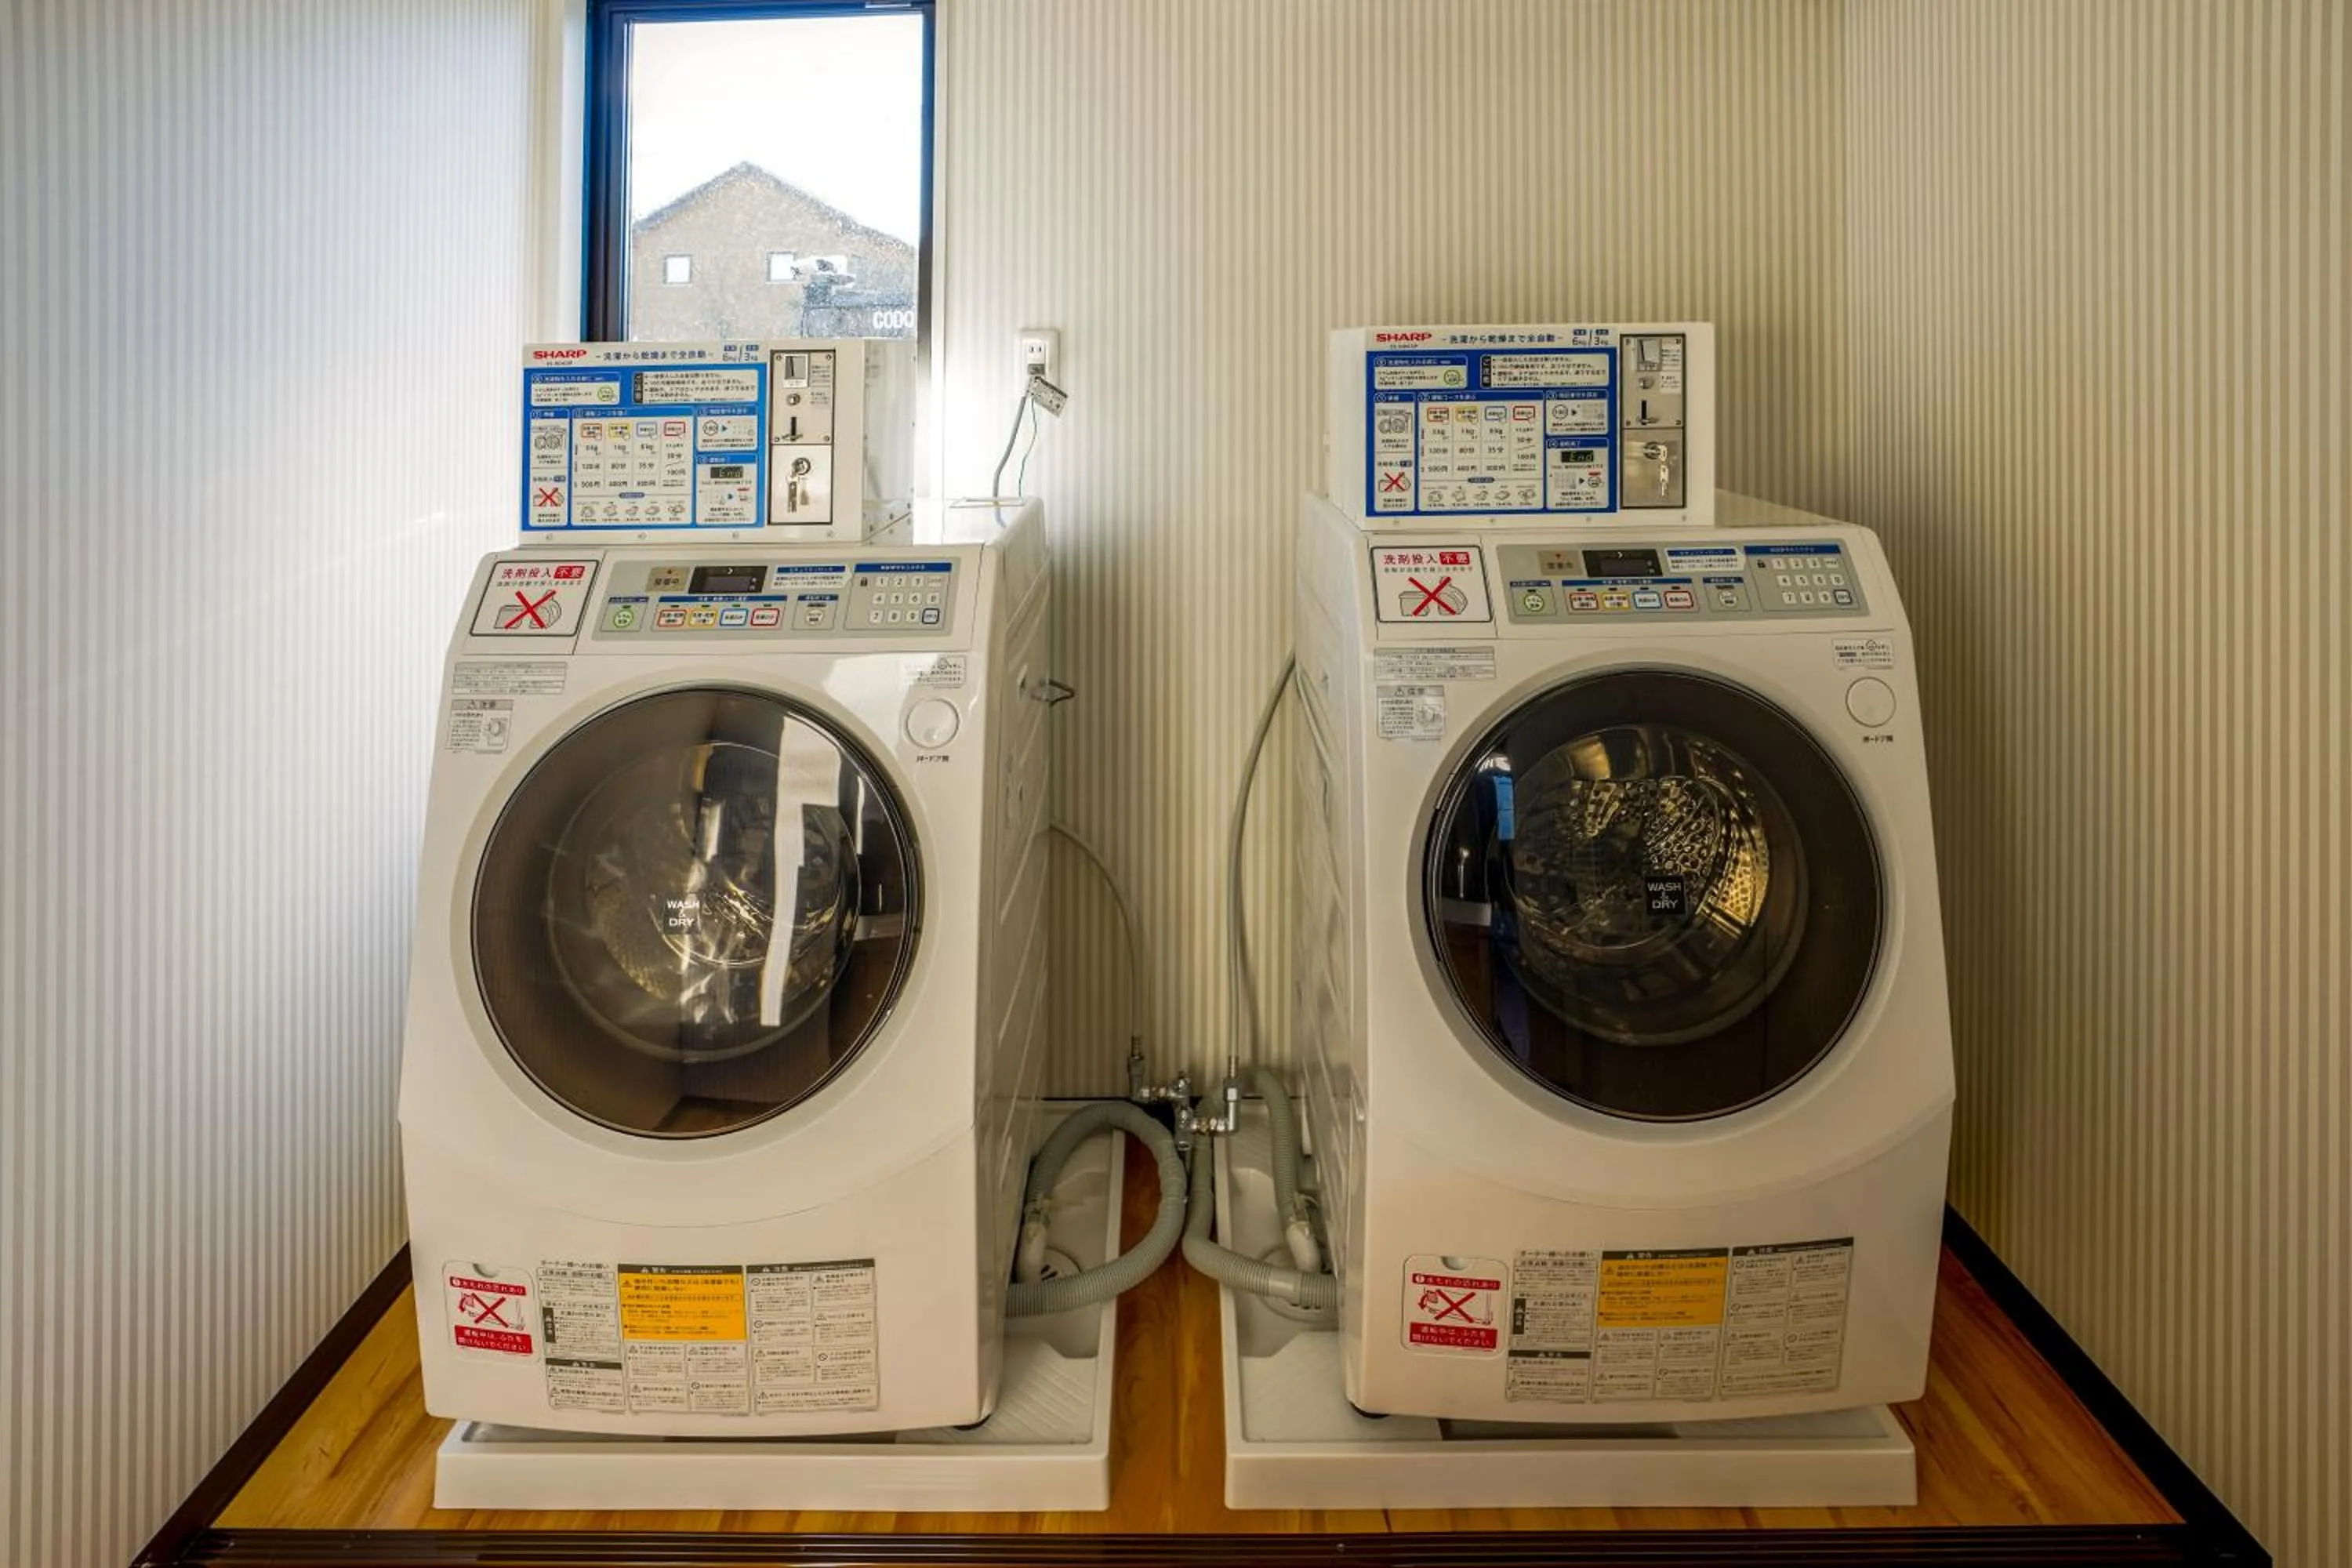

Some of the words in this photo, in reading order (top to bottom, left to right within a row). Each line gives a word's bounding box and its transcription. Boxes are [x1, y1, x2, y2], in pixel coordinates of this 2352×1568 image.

[1376, 332, 1432, 343] SHARP
[1449, 333, 1555, 344] 洗濯から乾燥まで全自動
[533, 349, 587, 360] SHARP
[603, 350, 706, 361] 洗濯から乾燥まで全自動
[1384, 553, 1438, 564] 洗剤投入
[502, 567, 551, 579] 洗剤投入
[1647, 882, 1682, 891] WASH
[1652, 900, 1679, 909] DRY
[669, 917, 695, 927] DRY
